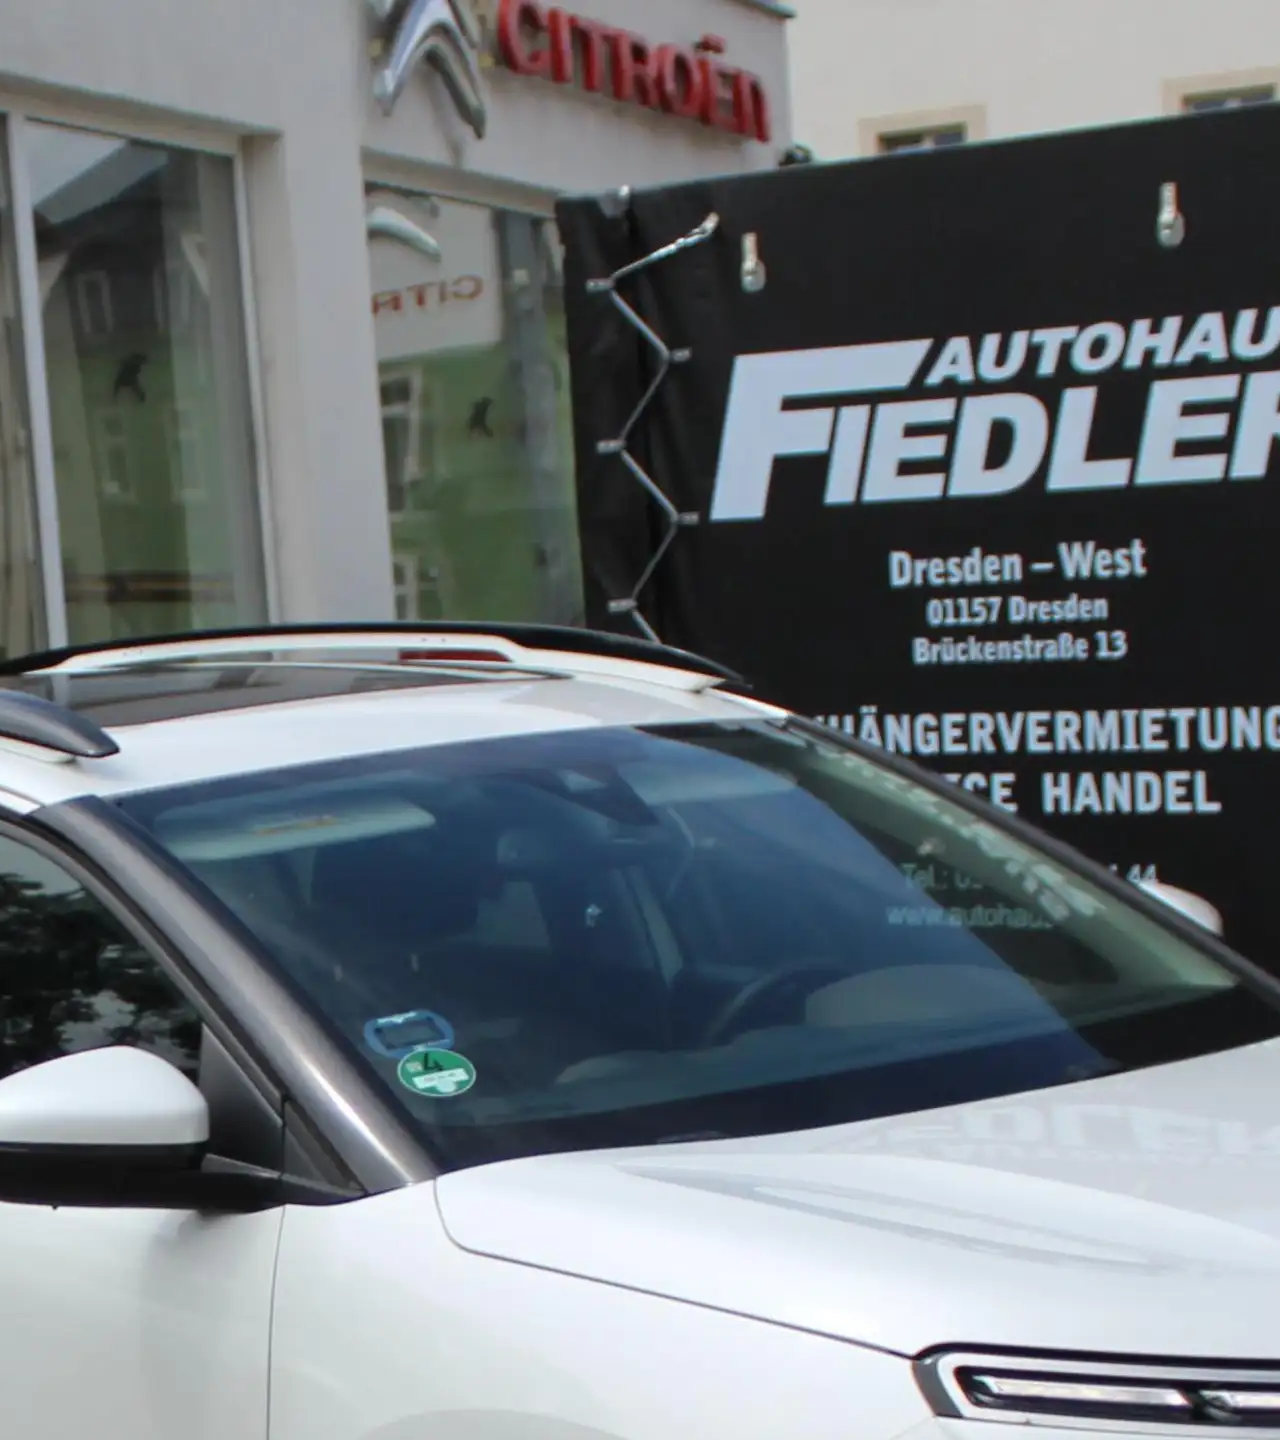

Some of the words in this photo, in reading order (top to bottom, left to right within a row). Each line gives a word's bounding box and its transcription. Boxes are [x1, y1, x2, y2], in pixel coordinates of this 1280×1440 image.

[889, 546, 1022, 588] Dresden
[1057, 538, 1148, 580] West
[926, 596, 1003, 627] 01157
[1007, 592, 1110, 624] Dresden
[911, 632, 1090, 665] Brückenstraße
[1094, 630, 1129, 661] 13
[1041, 770, 1222, 815] HANDEL
